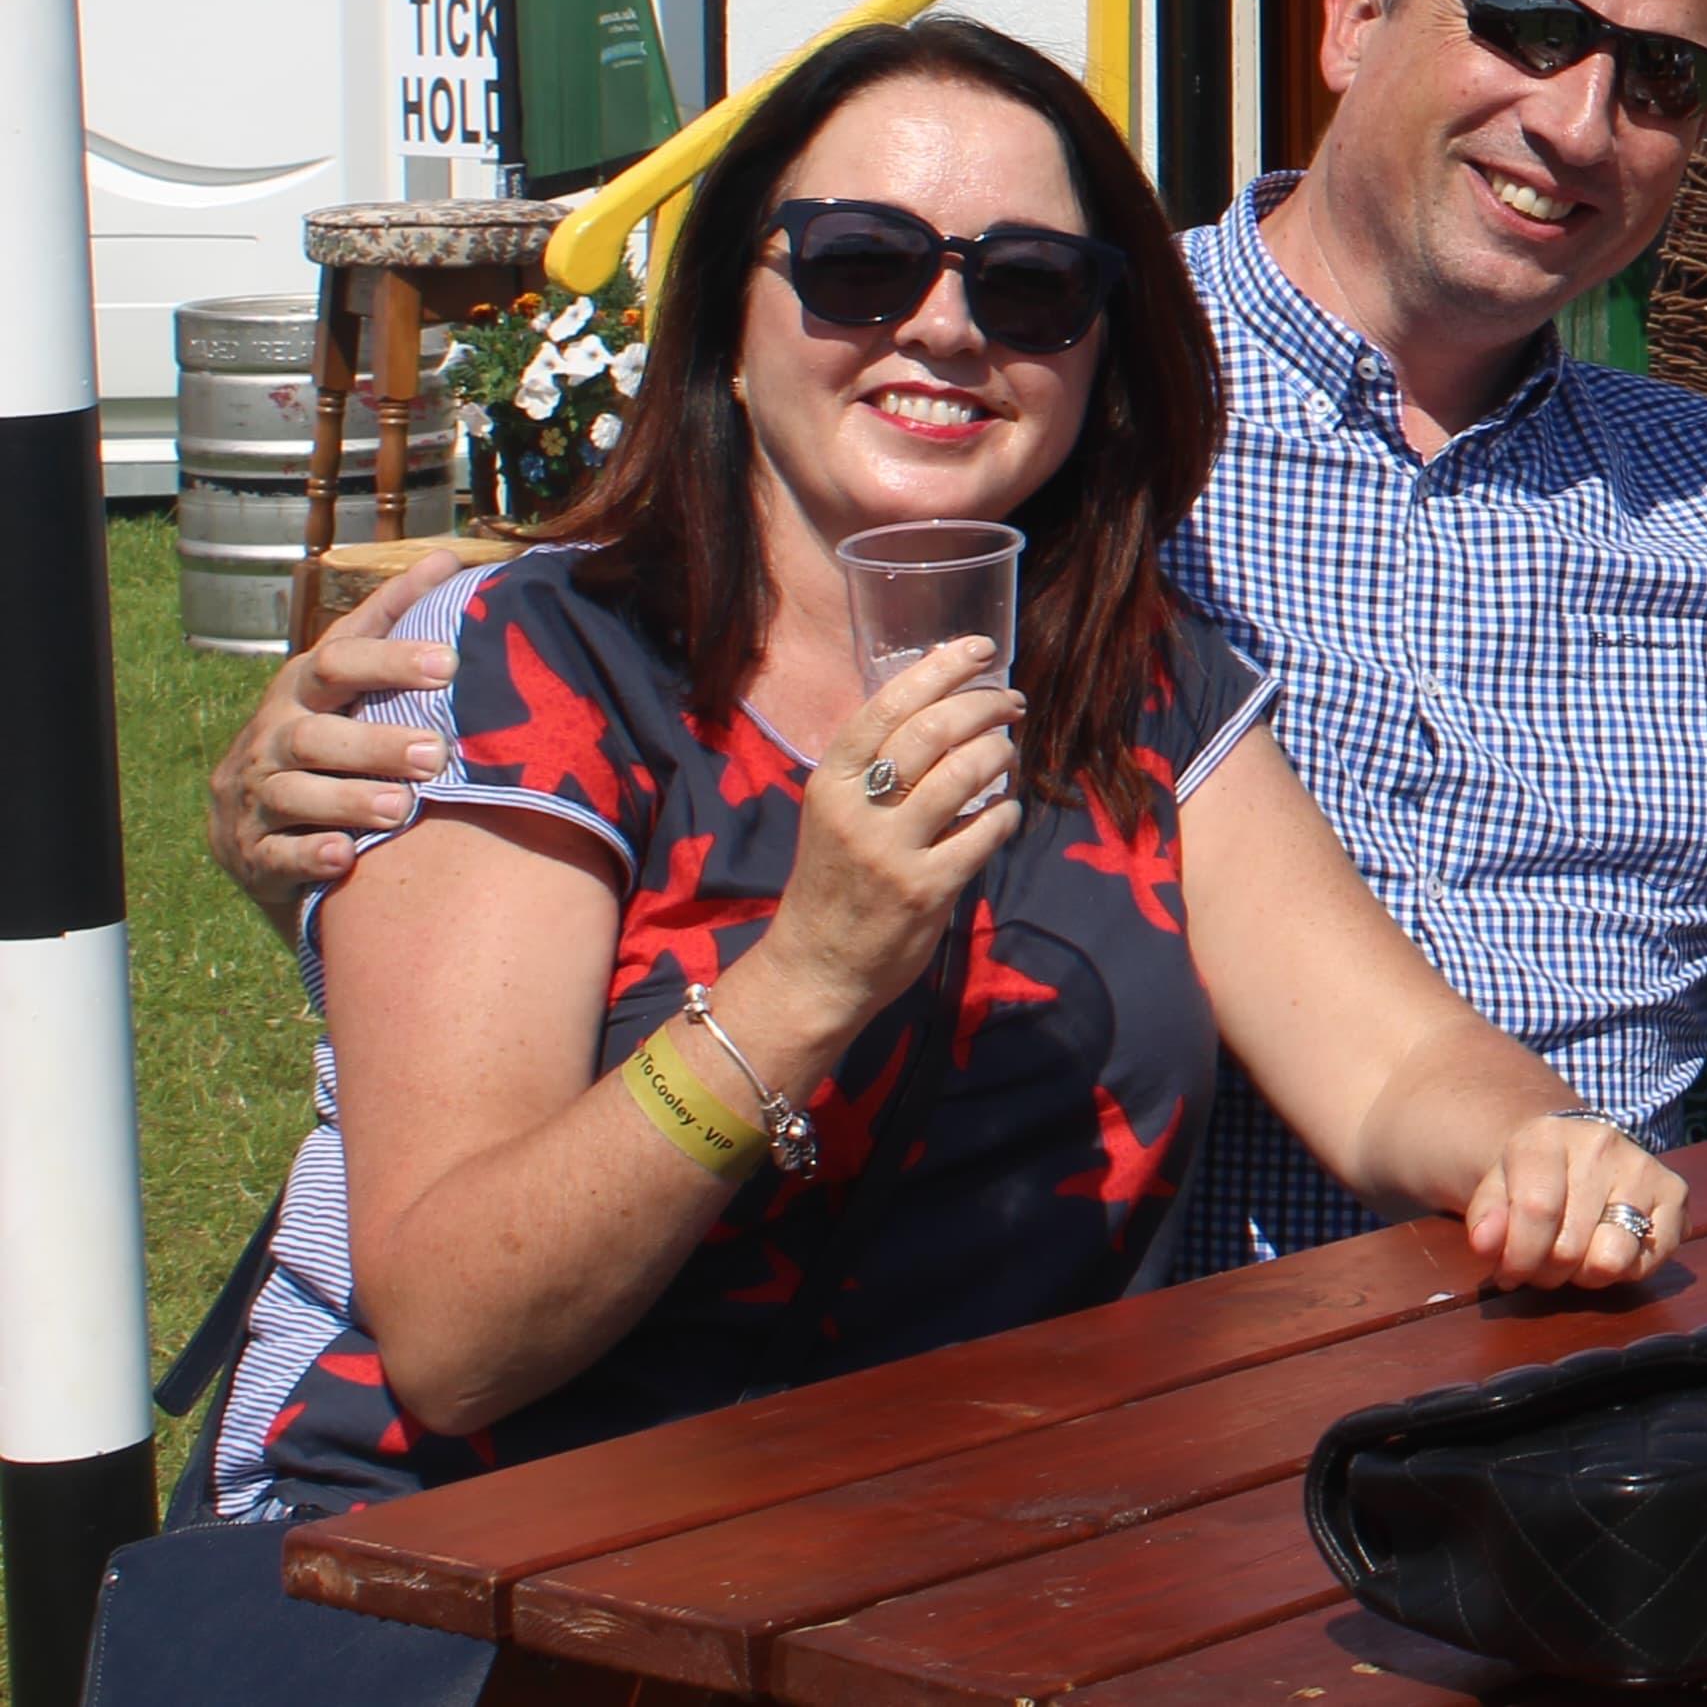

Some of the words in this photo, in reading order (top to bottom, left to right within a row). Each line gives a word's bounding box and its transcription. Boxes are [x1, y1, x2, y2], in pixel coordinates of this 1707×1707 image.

[640, 1053, 654, 1076] To
[652, 1073, 697, 1126] Cooley
[705, 1126, 735, 1150] VIP
